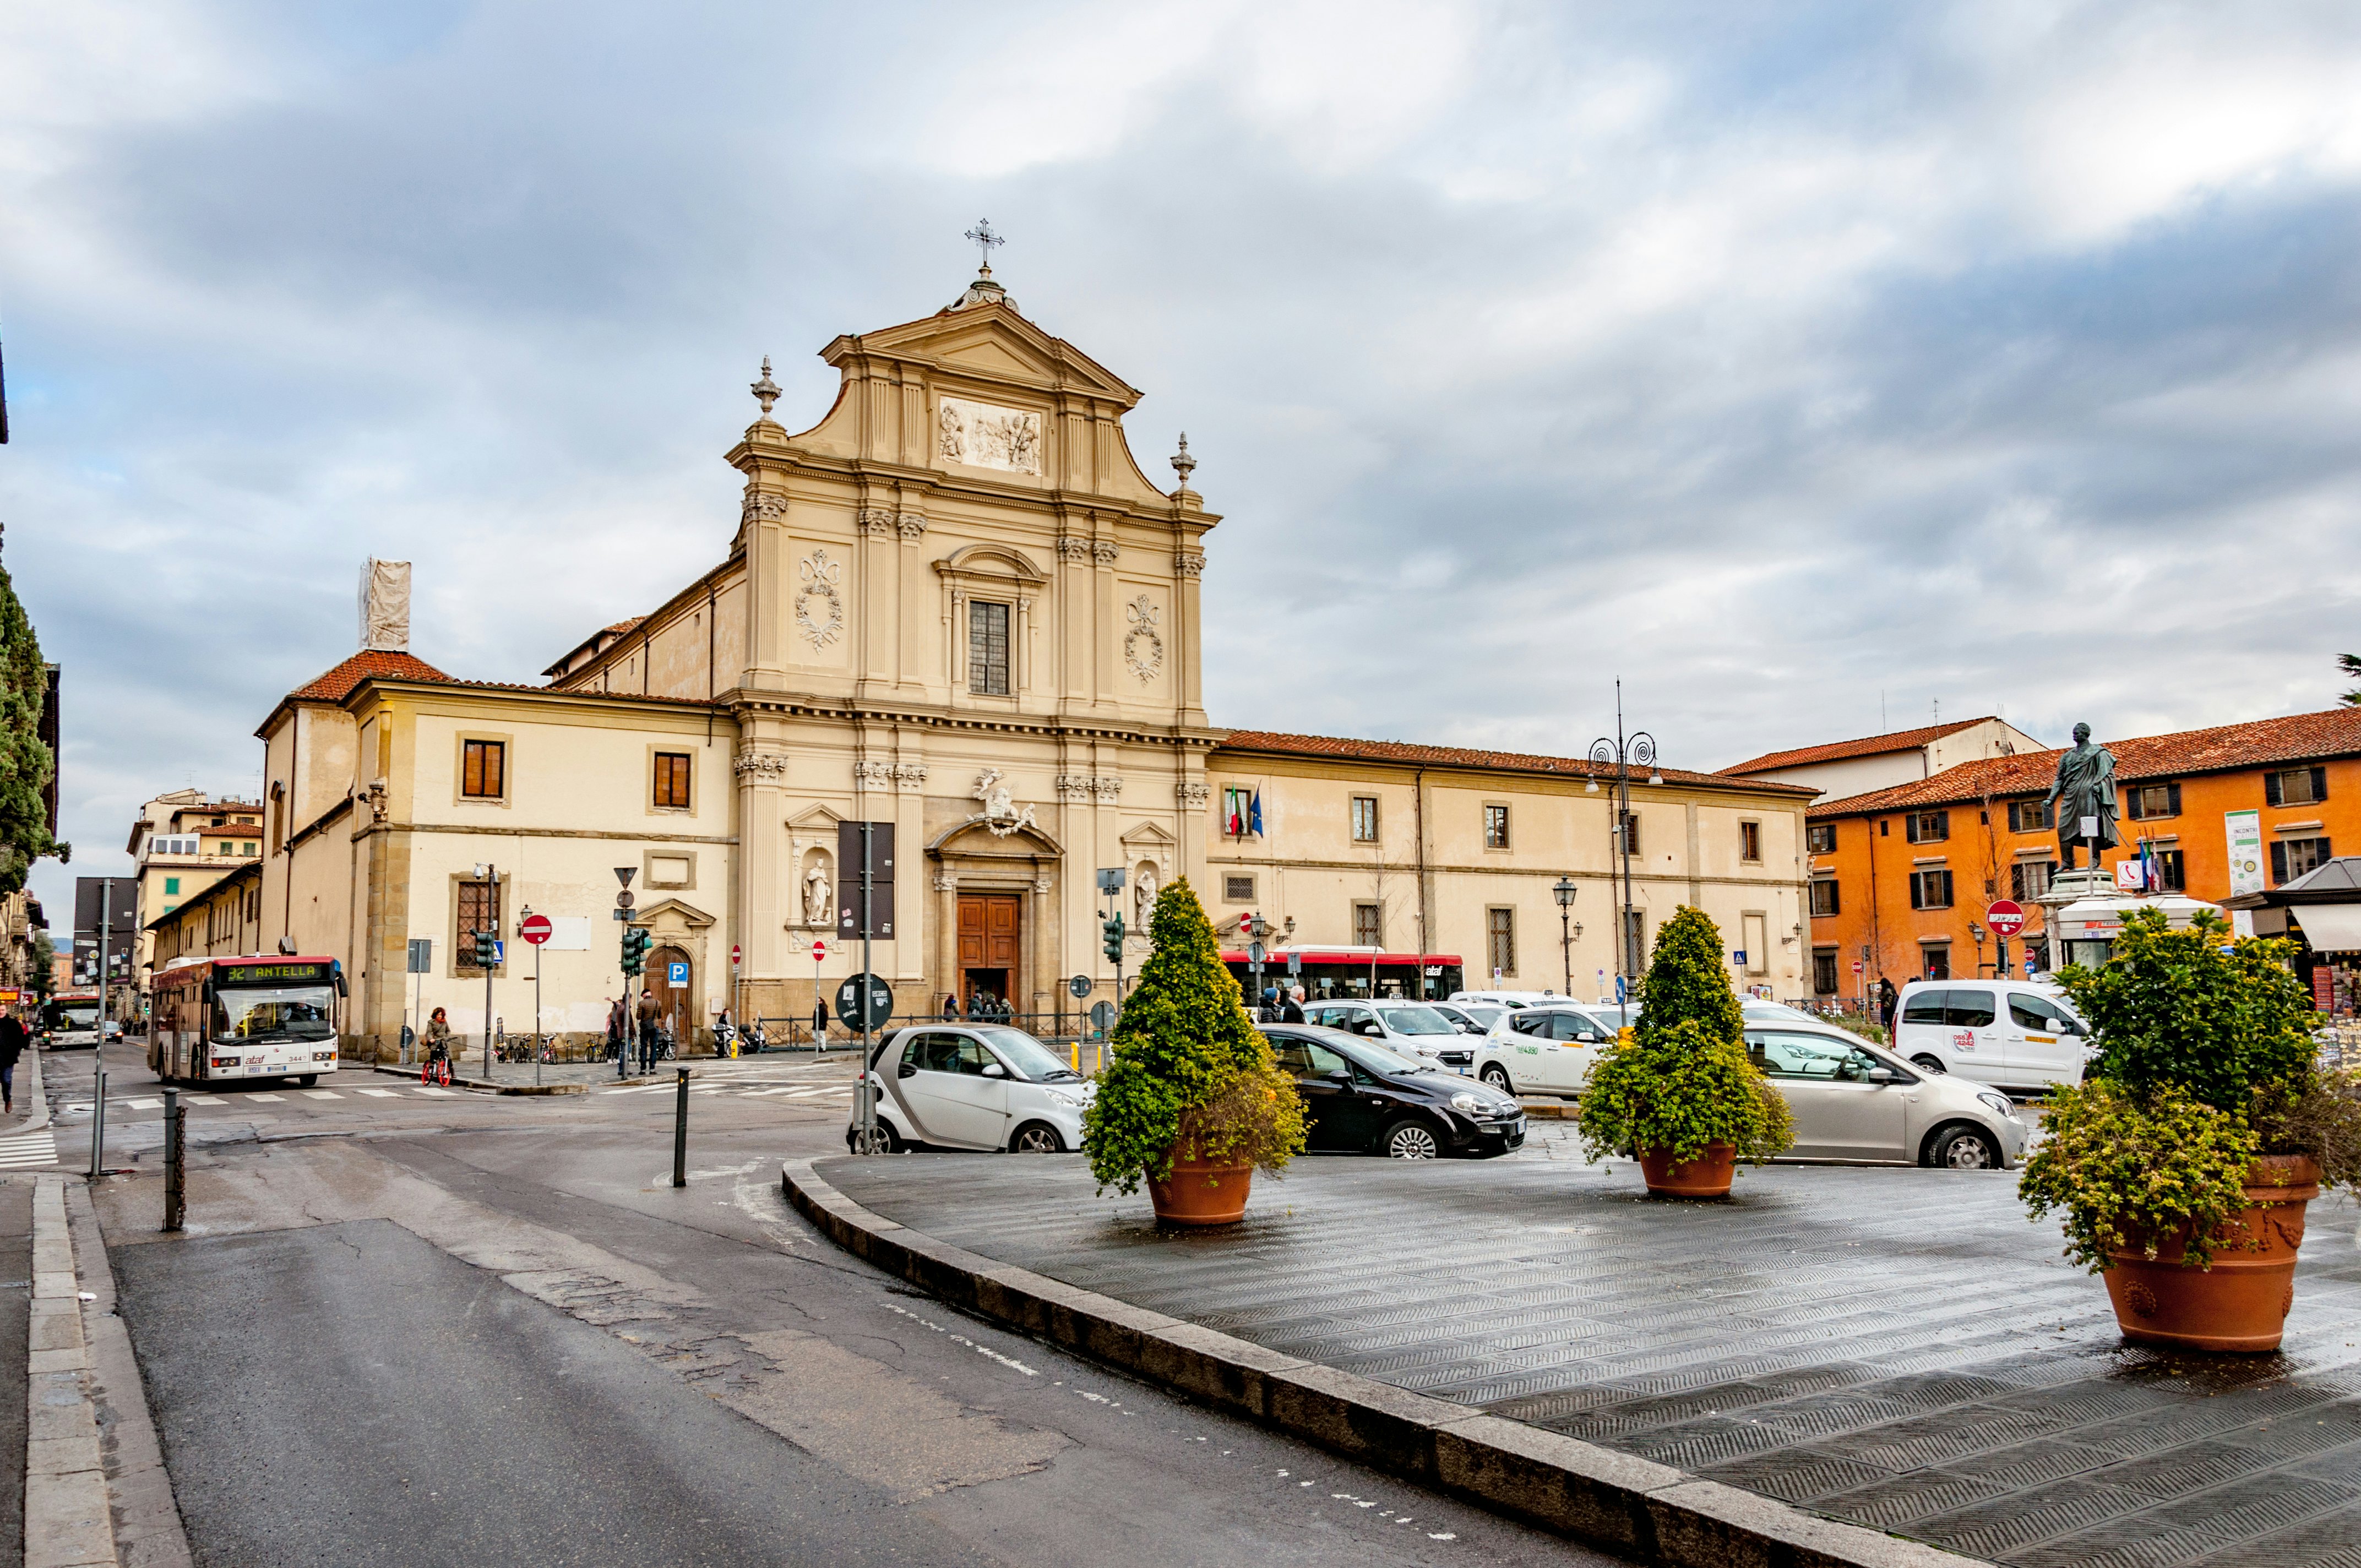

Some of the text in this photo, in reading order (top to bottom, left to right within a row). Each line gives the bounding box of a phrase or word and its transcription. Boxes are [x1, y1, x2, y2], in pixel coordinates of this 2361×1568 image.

[228, 966, 315, 979] 32 ANTELLA
[672, 965, 684, 979] P
[1426, 965, 1443, 976] ataf
[1524, 1046, 1538, 1055] 4390
[245, 1055, 265, 1064] ataf
